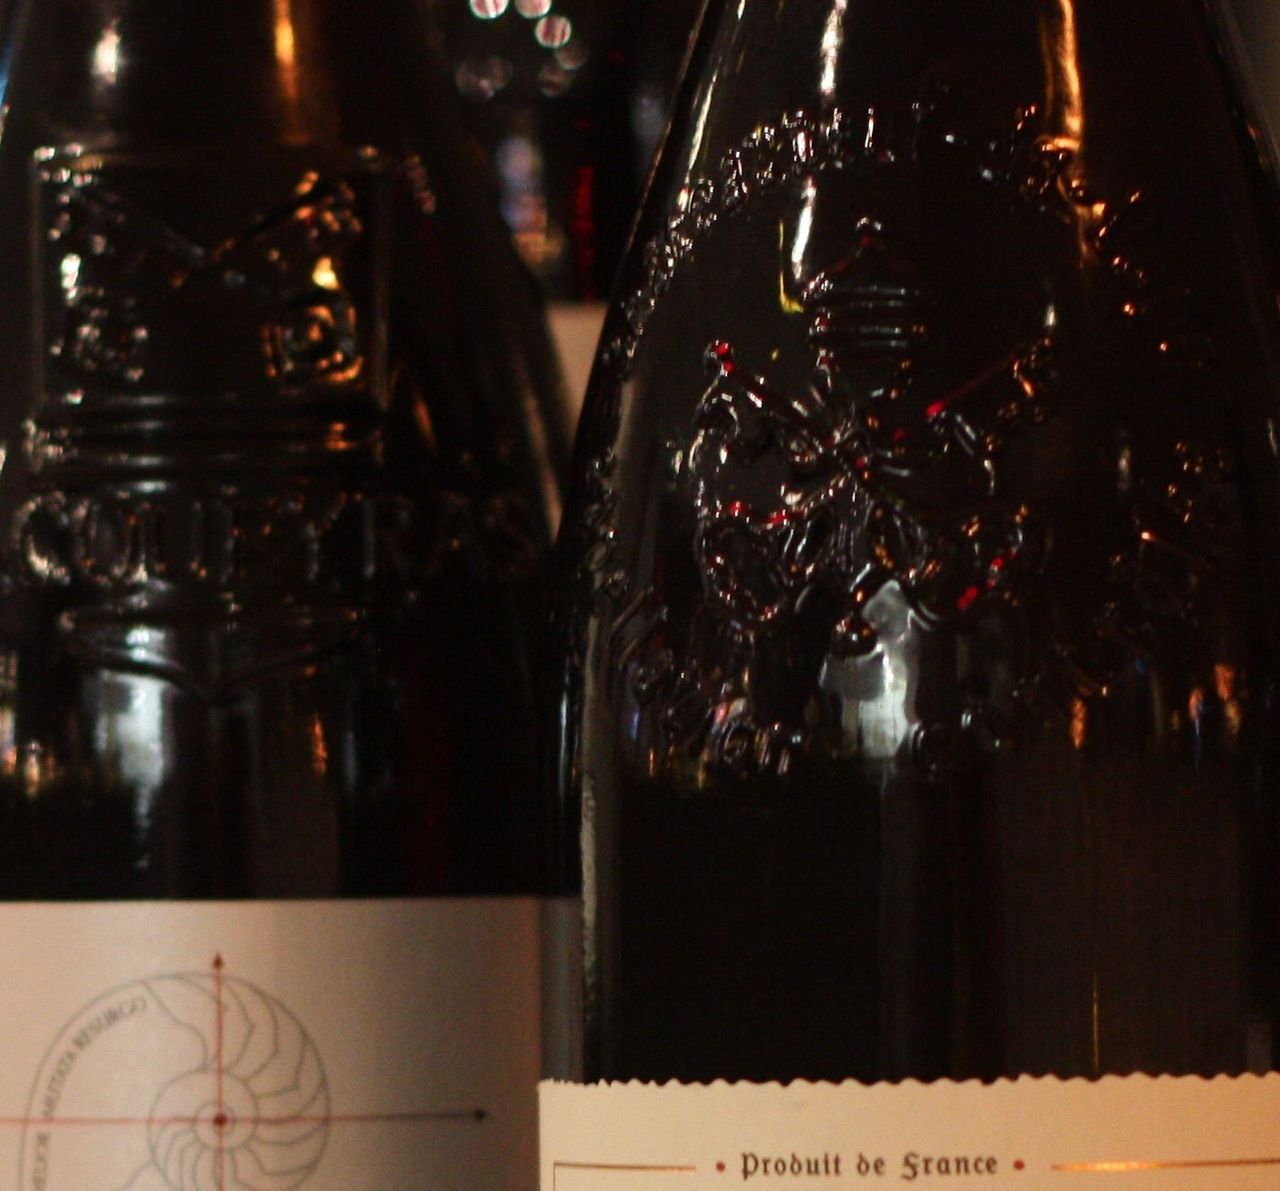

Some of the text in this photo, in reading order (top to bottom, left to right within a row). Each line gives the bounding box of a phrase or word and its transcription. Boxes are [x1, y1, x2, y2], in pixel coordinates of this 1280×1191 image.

[740, 1150, 999, 1182] Produit de France
